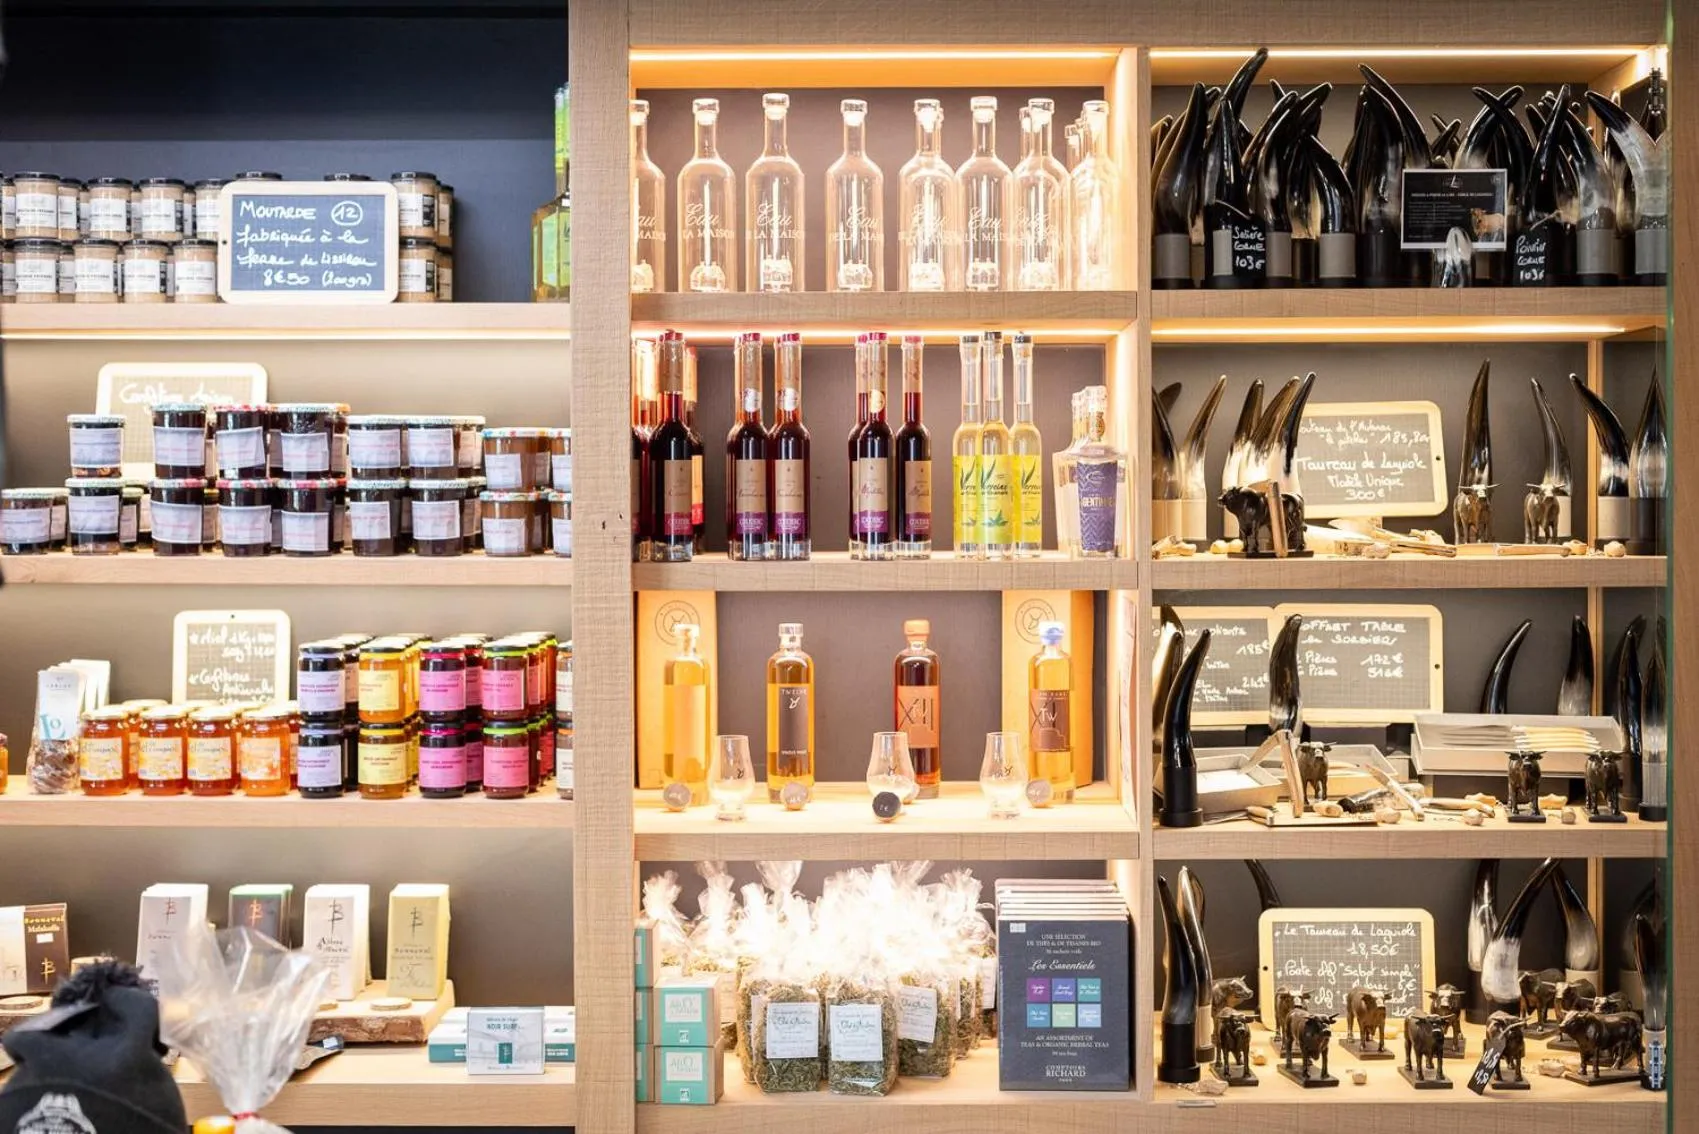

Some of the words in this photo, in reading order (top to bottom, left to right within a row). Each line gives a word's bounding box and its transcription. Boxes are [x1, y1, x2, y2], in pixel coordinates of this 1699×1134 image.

[239, 201, 316, 220] MOUTARDE
[320, 229, 332, 243] à
[337, 230, 369, 244] la
[1295, 456, 1357, 472] Taureau
[1361, 451, 1375, 470] de
[1283, 924, 1299, 936] Le
[1300, 925, 1346, 937] Taureau
[1351, 924, 1364, 936] de
[1371, 922, 1417, 944] Laguiole
[1347, 942, 1400, 960] 18,50€
[1028, 959, 1047, 971] Les
[1049, 959, 1096, 970] Essentiels
